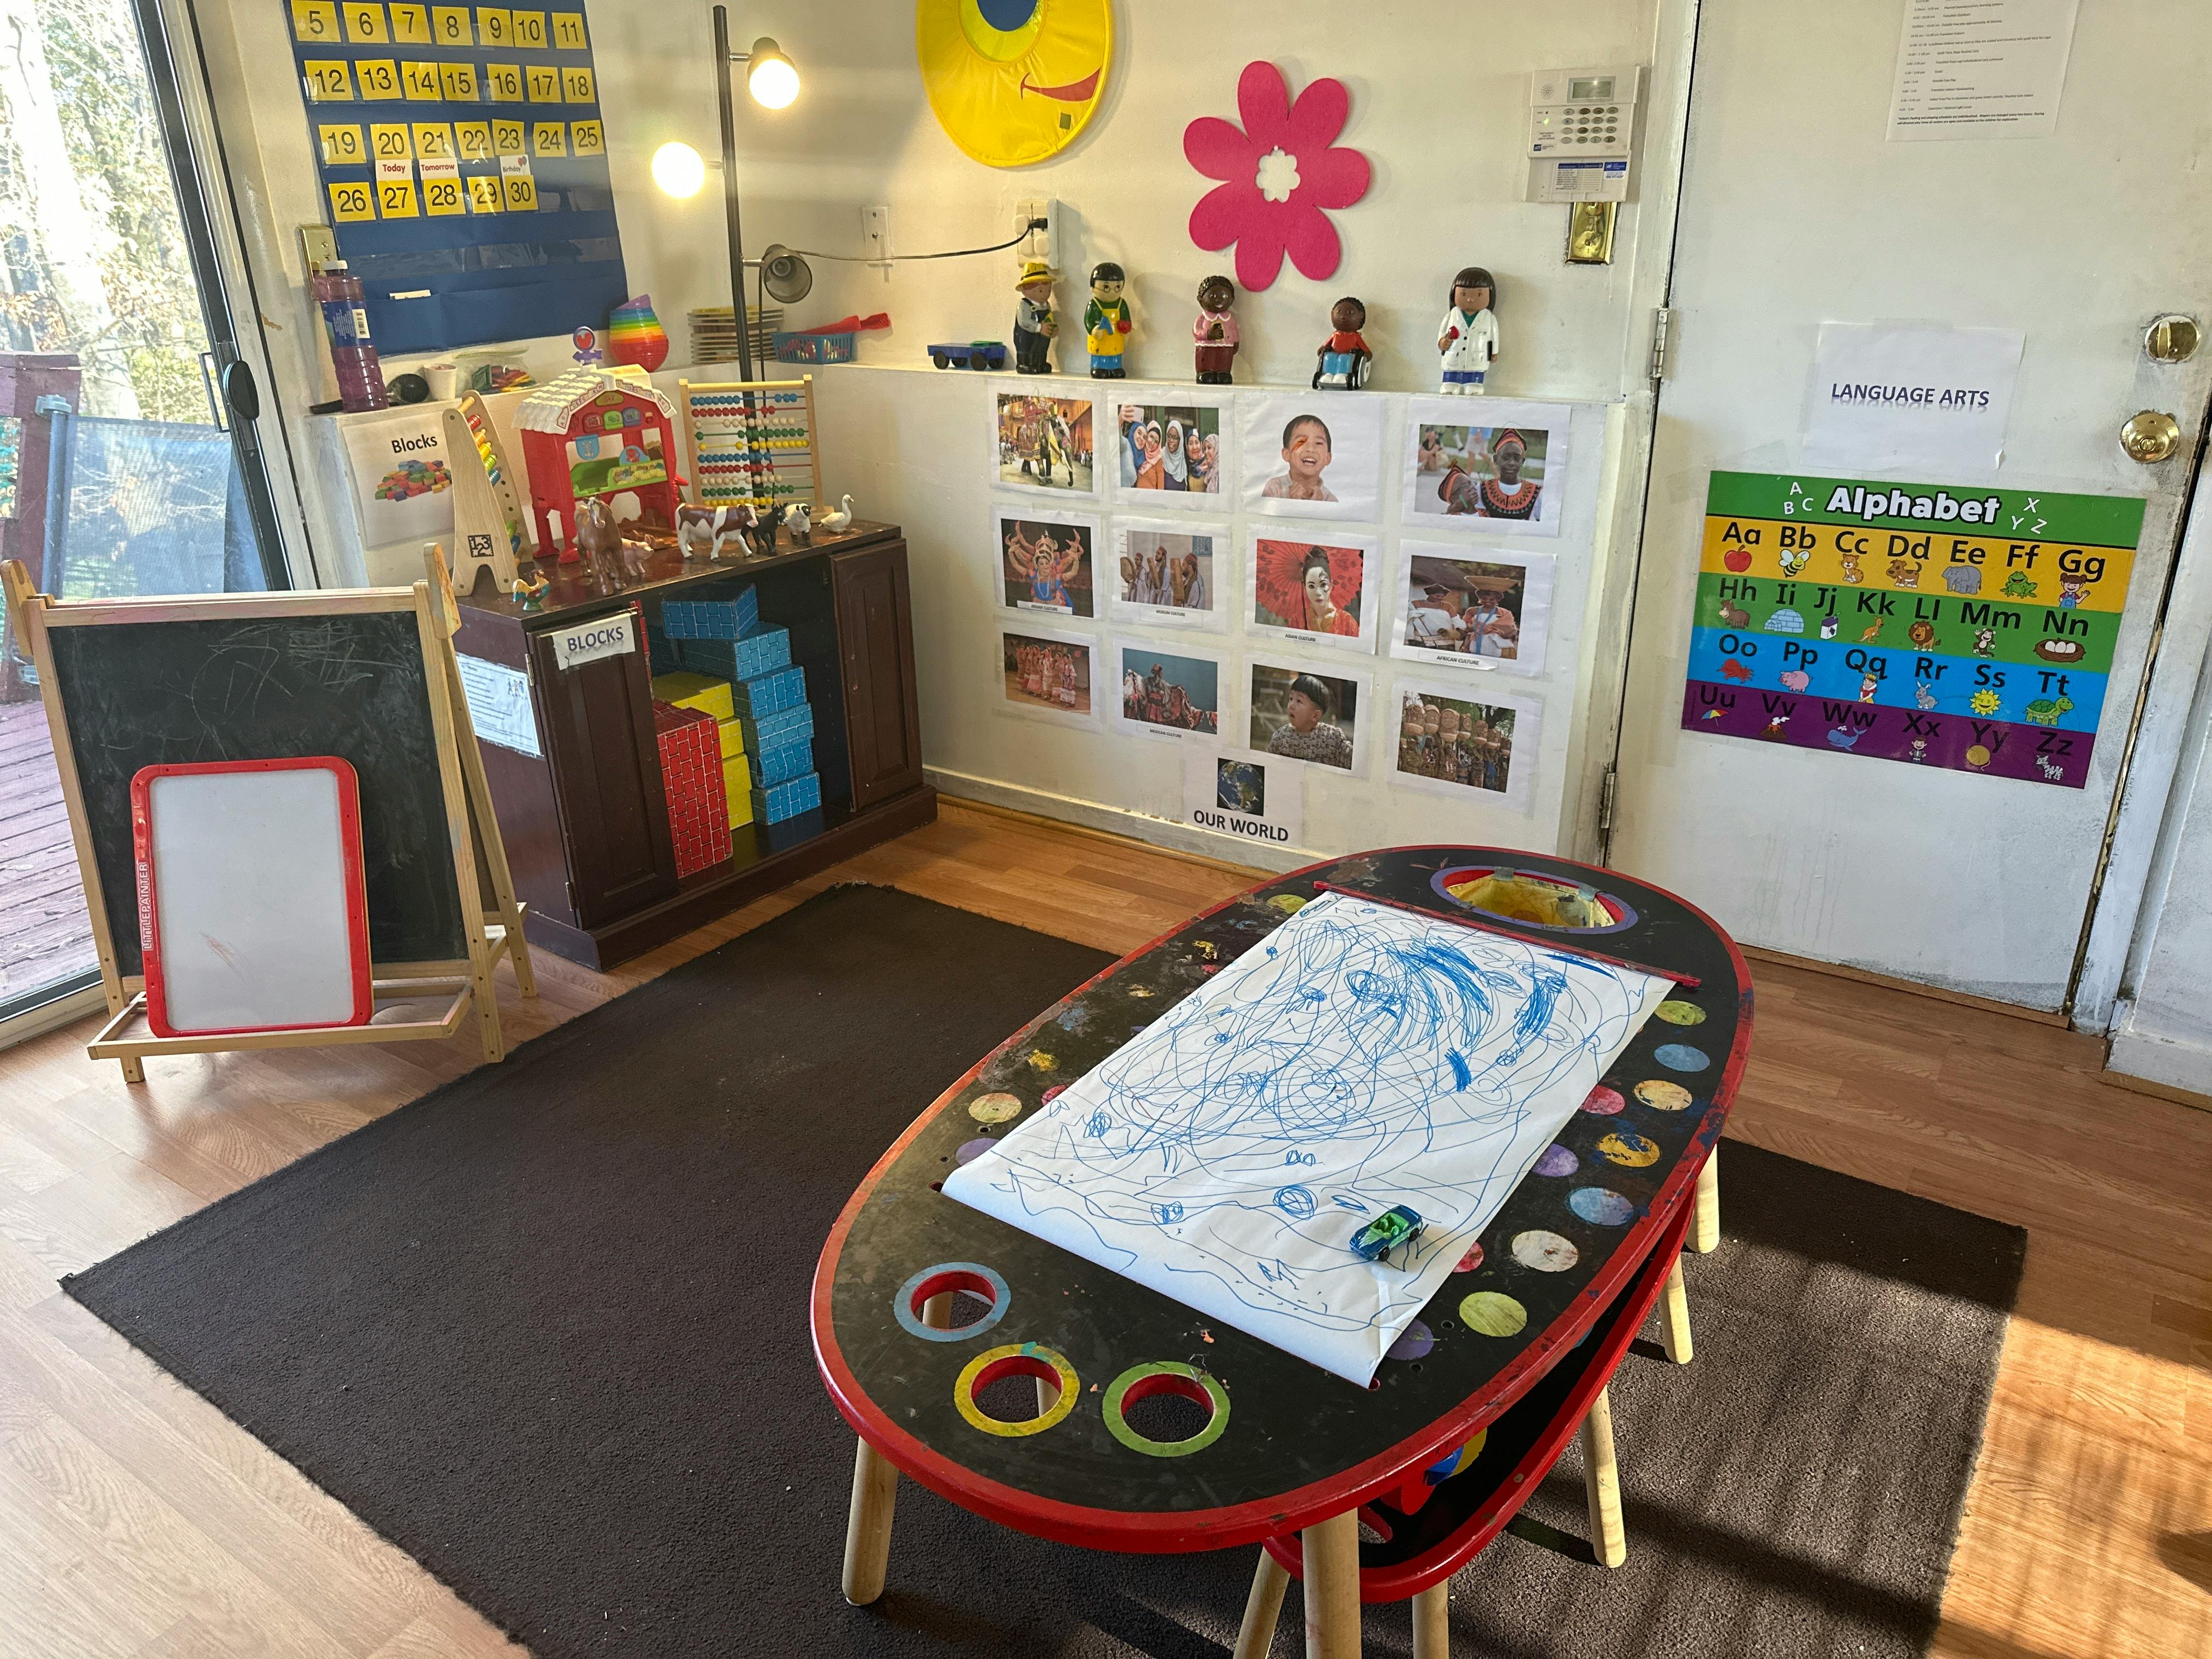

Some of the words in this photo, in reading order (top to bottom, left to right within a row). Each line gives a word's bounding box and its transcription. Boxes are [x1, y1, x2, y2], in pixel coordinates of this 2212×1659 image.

[308, 10, 324, 35] 5
[359, 12, 374, 36] 6
[402, 11, 414, 33] 7
[446, 15, 459, 38] 8
[489, 16, 502, 39] 9
[518, 19, 540, 41] 10
[561, 21, 578, 42] 11
[314, 69, 345, 93] 12
[364, 67, 392, 91] 13
[409, 71, 435, 93] 14
[447, 72, 471, 94] 15
[494, 72, 516, 95] 16
[533, 75, 554, 95] 17
[568, 76, 589, 97] 18
[328, 131, 356, 155] 19
[379, 132, 405, 155] 20
[422, 131, 446, 154] 21
[463, 129, 488, 151] 22
[498, 128, 521, 150] 23
[539, 129, 561, 150] 24
[577, 127, 598, 148] 25
[383, 164, 405, 173] Today
[421, 163, 455, 172] Tomorrow
[337, 189, 366, 213] 26
[384, 187, 409, 210] 27
[430, 184, 457, 206] 28
[474, 182, 498, 204] 29
[510, 181, 531, 202] 30
[1831, 383, 1935, 403] LANGUAGE
[1939, 389, 1989, 406] ARTS
[391, 434, 438, 453] Blocks
[1789, 482, 1803, 495] A
[1783, 501, 1795, 515] B
[1802, 498, 1814, 511] C
[1825, 486, 2001, 524] Alphabet
[2023, 497, 2040, 514] X
[2011, 515, 2024, 530] Y
[2030, 518, 2047, 534] Z
[1722, 522, 1760, 544] Aa
[1780, 526, 1816, 549] Bb
[1836, 531, 1869, 554] Cc
[1888, 535, 1931, 560] Dd
[1950, 540, 1986, 564] Ee
[2007, 545, 2039, 568] Ff
[2058, 549, 2106, 583] Gg
[1719, 578, 1756, 601] Hh
[1776, 583, 1795, 605] Ii
[1813, 588, 1836, 617] Jj
[1858, 592, 1895, 616] Kk
[1915, 597, 1940, 620] Ll
[1961, 602, 2021, 629] Mm
[2043, 611, 2088, 636] Nn
[567, 627, 624, 651] BLOCKS
[1436, 655, 1457, 663] AFRICAN
[1719, 634, 1757, 657] Oo
[1784, 642, 1818, 670] Pp
[1845, 649, 1888, 680] Qq
[1915, 657, 1948, 679] Rr
[1975, 664, 2005, 687] Ss
[2038, 671, 2069, 696] Tt
[1700, 684, 1735, 708] Uu
[1762, 693, 1797, 717] Vv
[1822, 701, 1877, 727] Ww
[1902, 712, 1942, 738] Xx
[1971, 721, 2010, 754] Yy
[2036, 731, 2074, 756] Zz
[1194, 810, 1225, 830] OUR
[1230, 817, 1289, 842] WORLD
